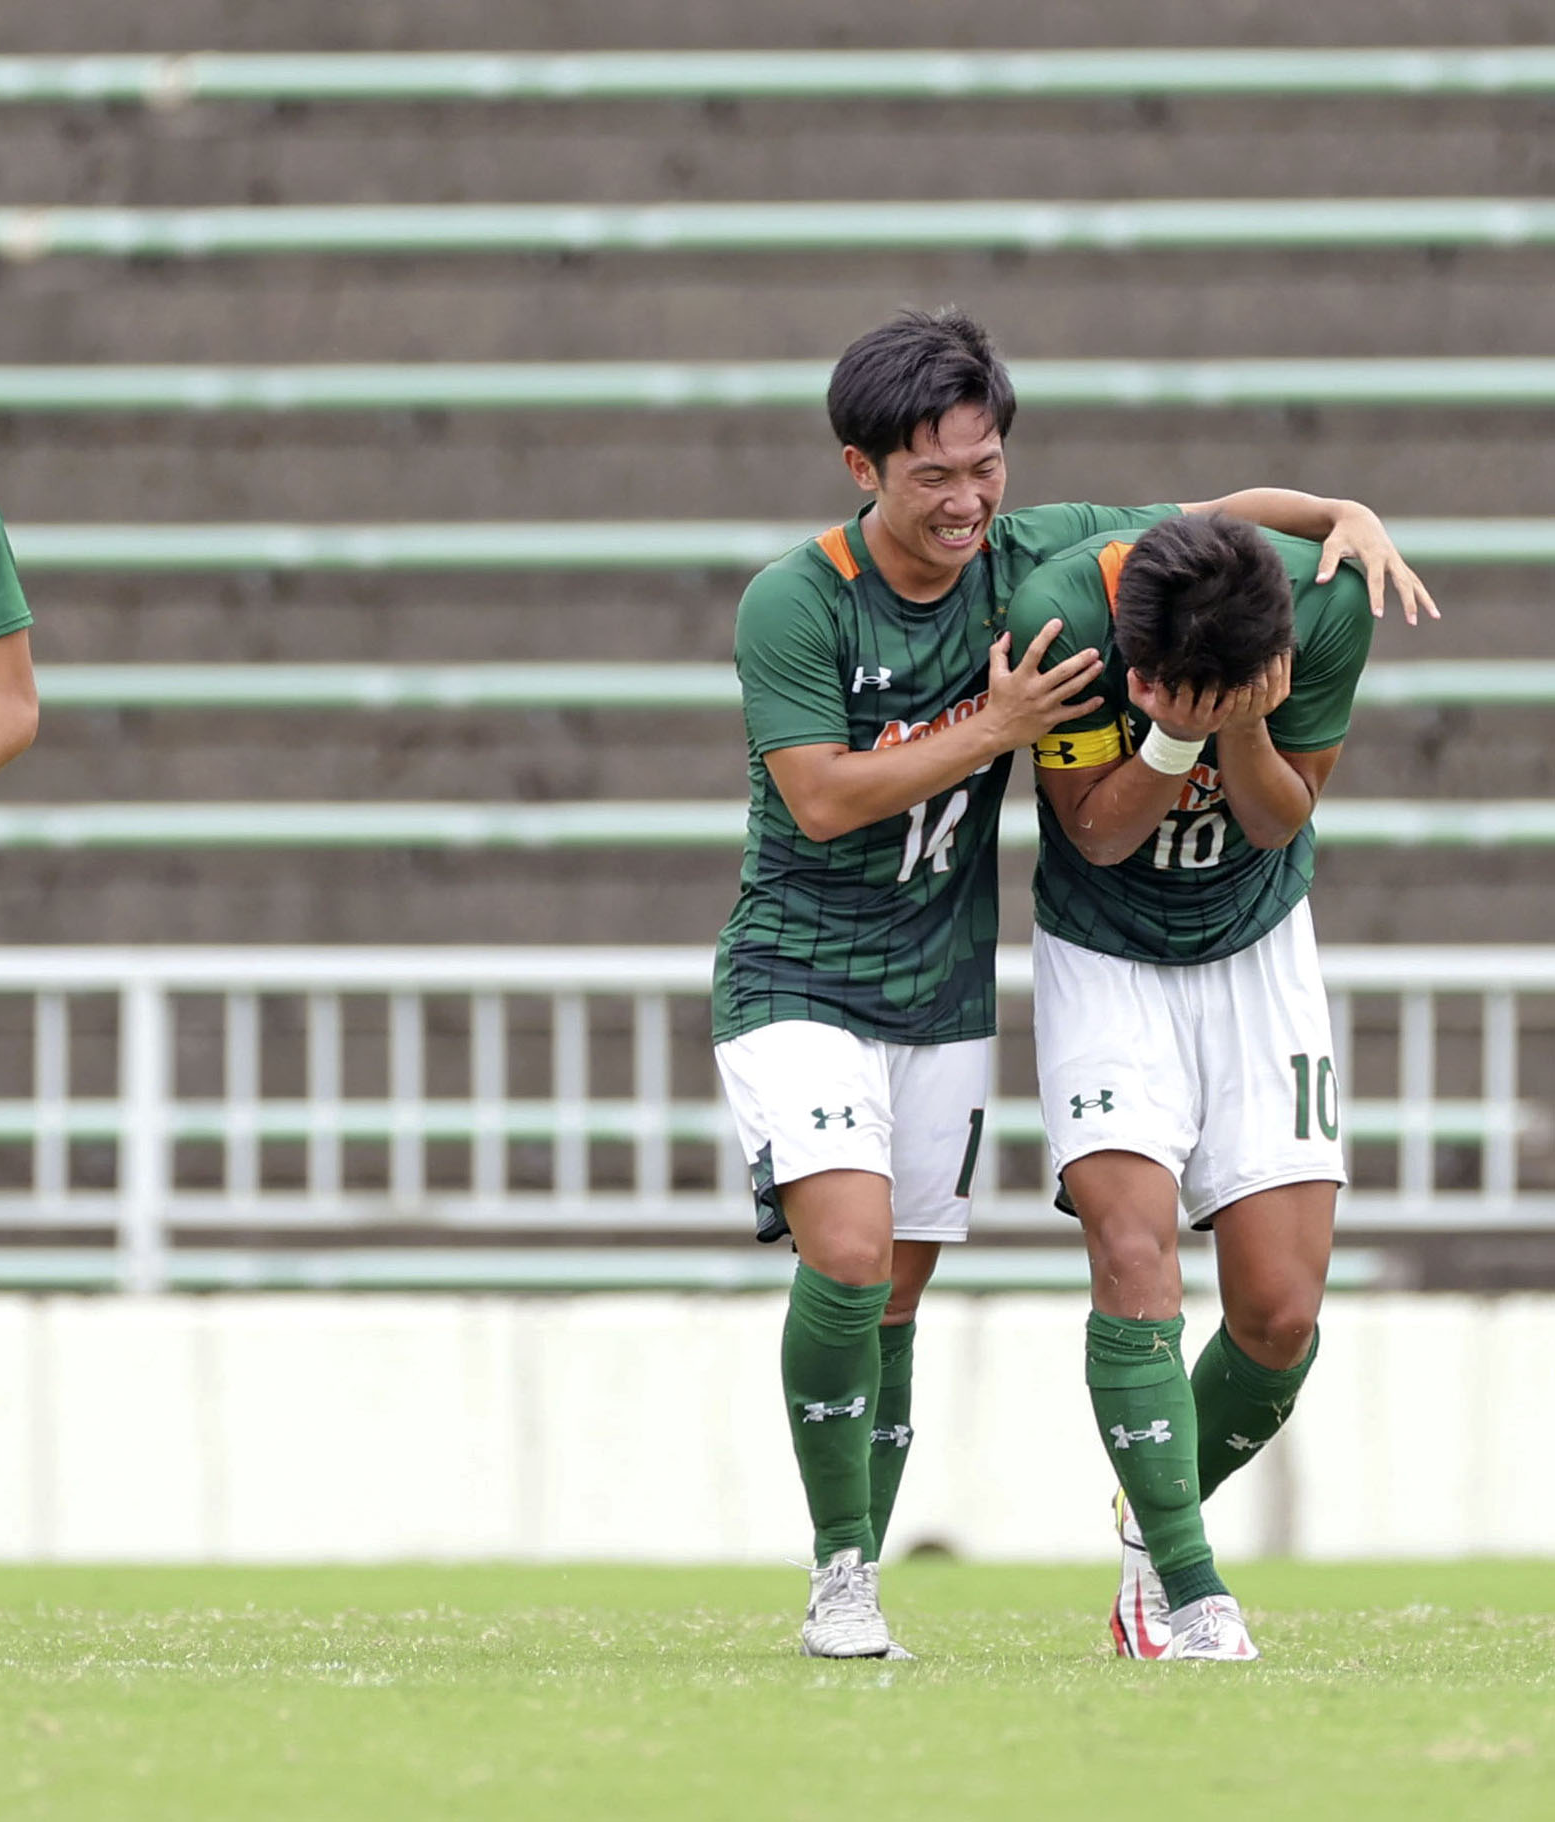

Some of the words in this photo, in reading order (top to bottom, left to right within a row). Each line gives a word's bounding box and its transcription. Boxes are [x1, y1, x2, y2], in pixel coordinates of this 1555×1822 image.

[872, 690, 991, 753] AOMO
[896, 789, 969, 882] 14
[1153, 812, 1228, 870] 10
[1289, 1053, 1339, 1142] 10
[953, 1107, 985, 1199] 1
